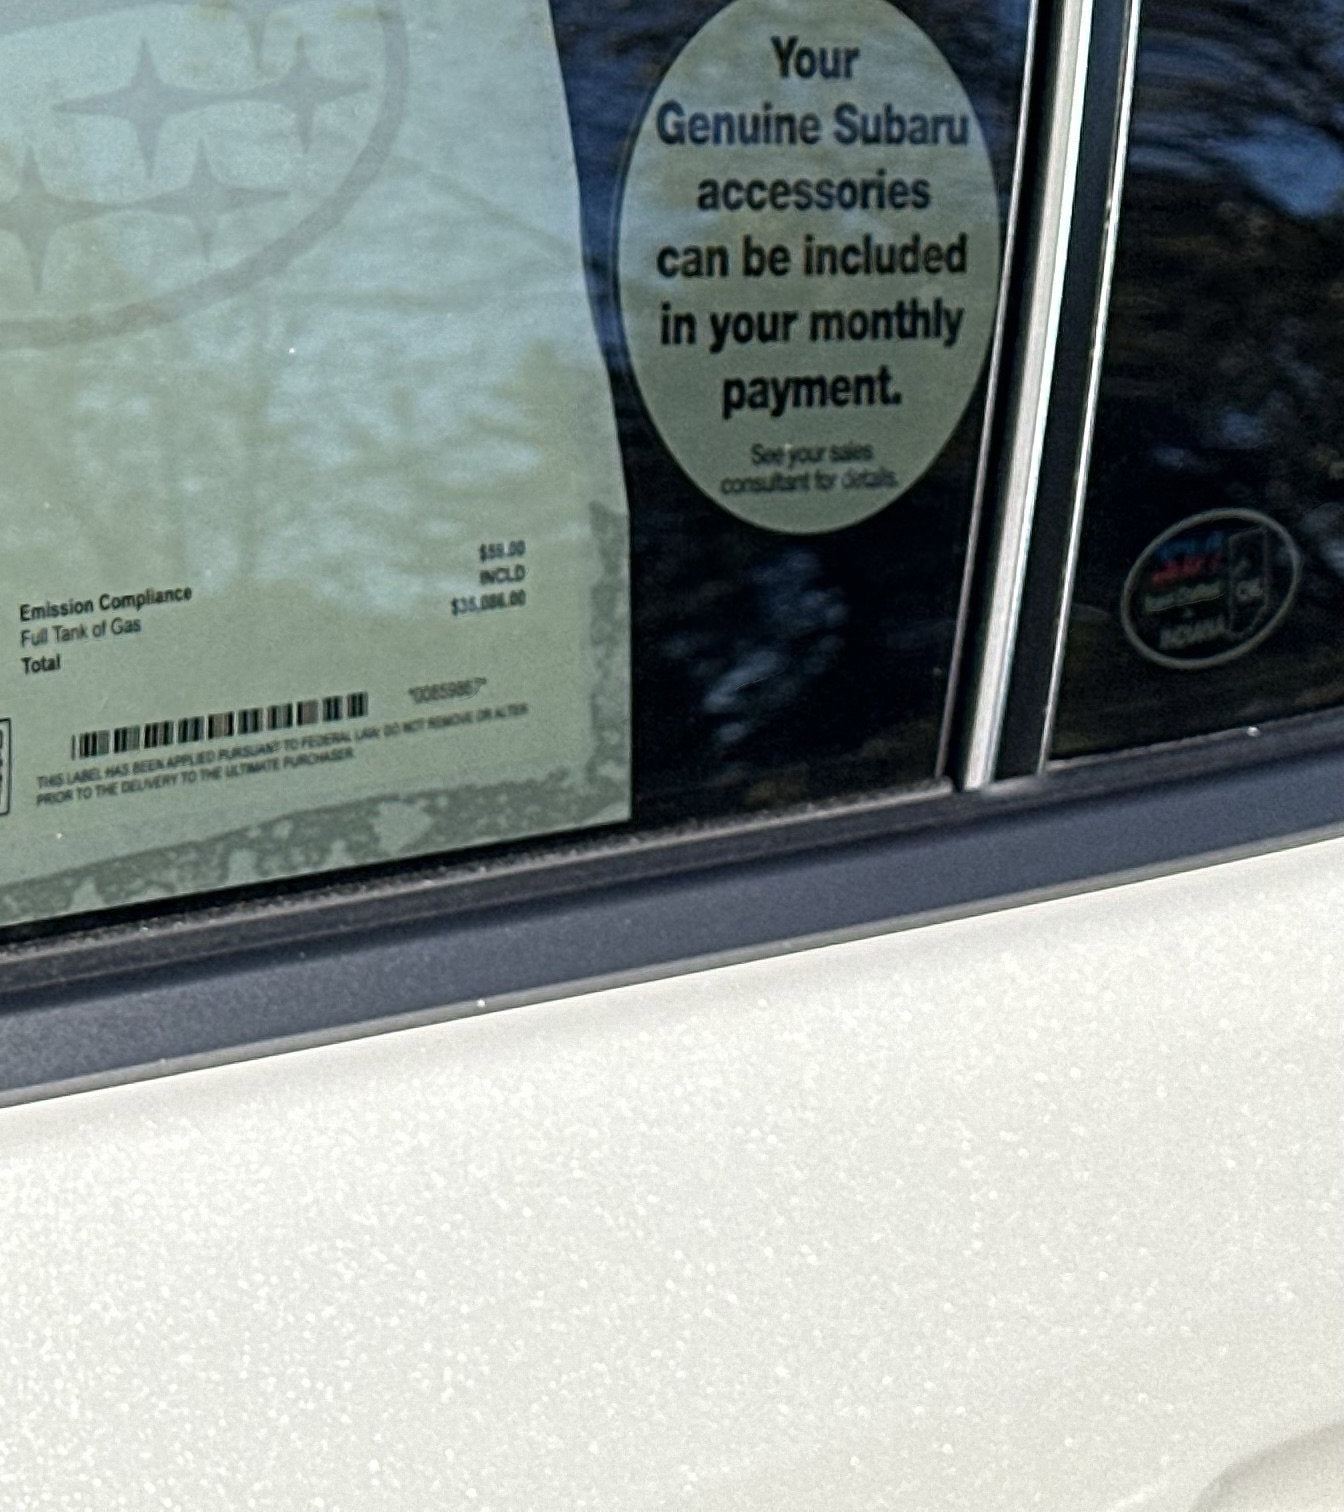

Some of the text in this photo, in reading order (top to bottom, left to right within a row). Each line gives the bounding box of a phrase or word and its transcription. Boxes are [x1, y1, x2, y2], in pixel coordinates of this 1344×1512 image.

[770, 35, 861, 80] Your
[655, 99, 971, 147] Genuine Subaru
[696, 167, 932, 213] accessories
[655, 232, 968, 279] can be included
[660, 297, 965, 355] in your monthly
[721, 364, 903, 421] payment.
[787, 446, 827, 471] your
[19, 586, 193, 623] Emission Compliance
[20, 653, 62, 675] Total
